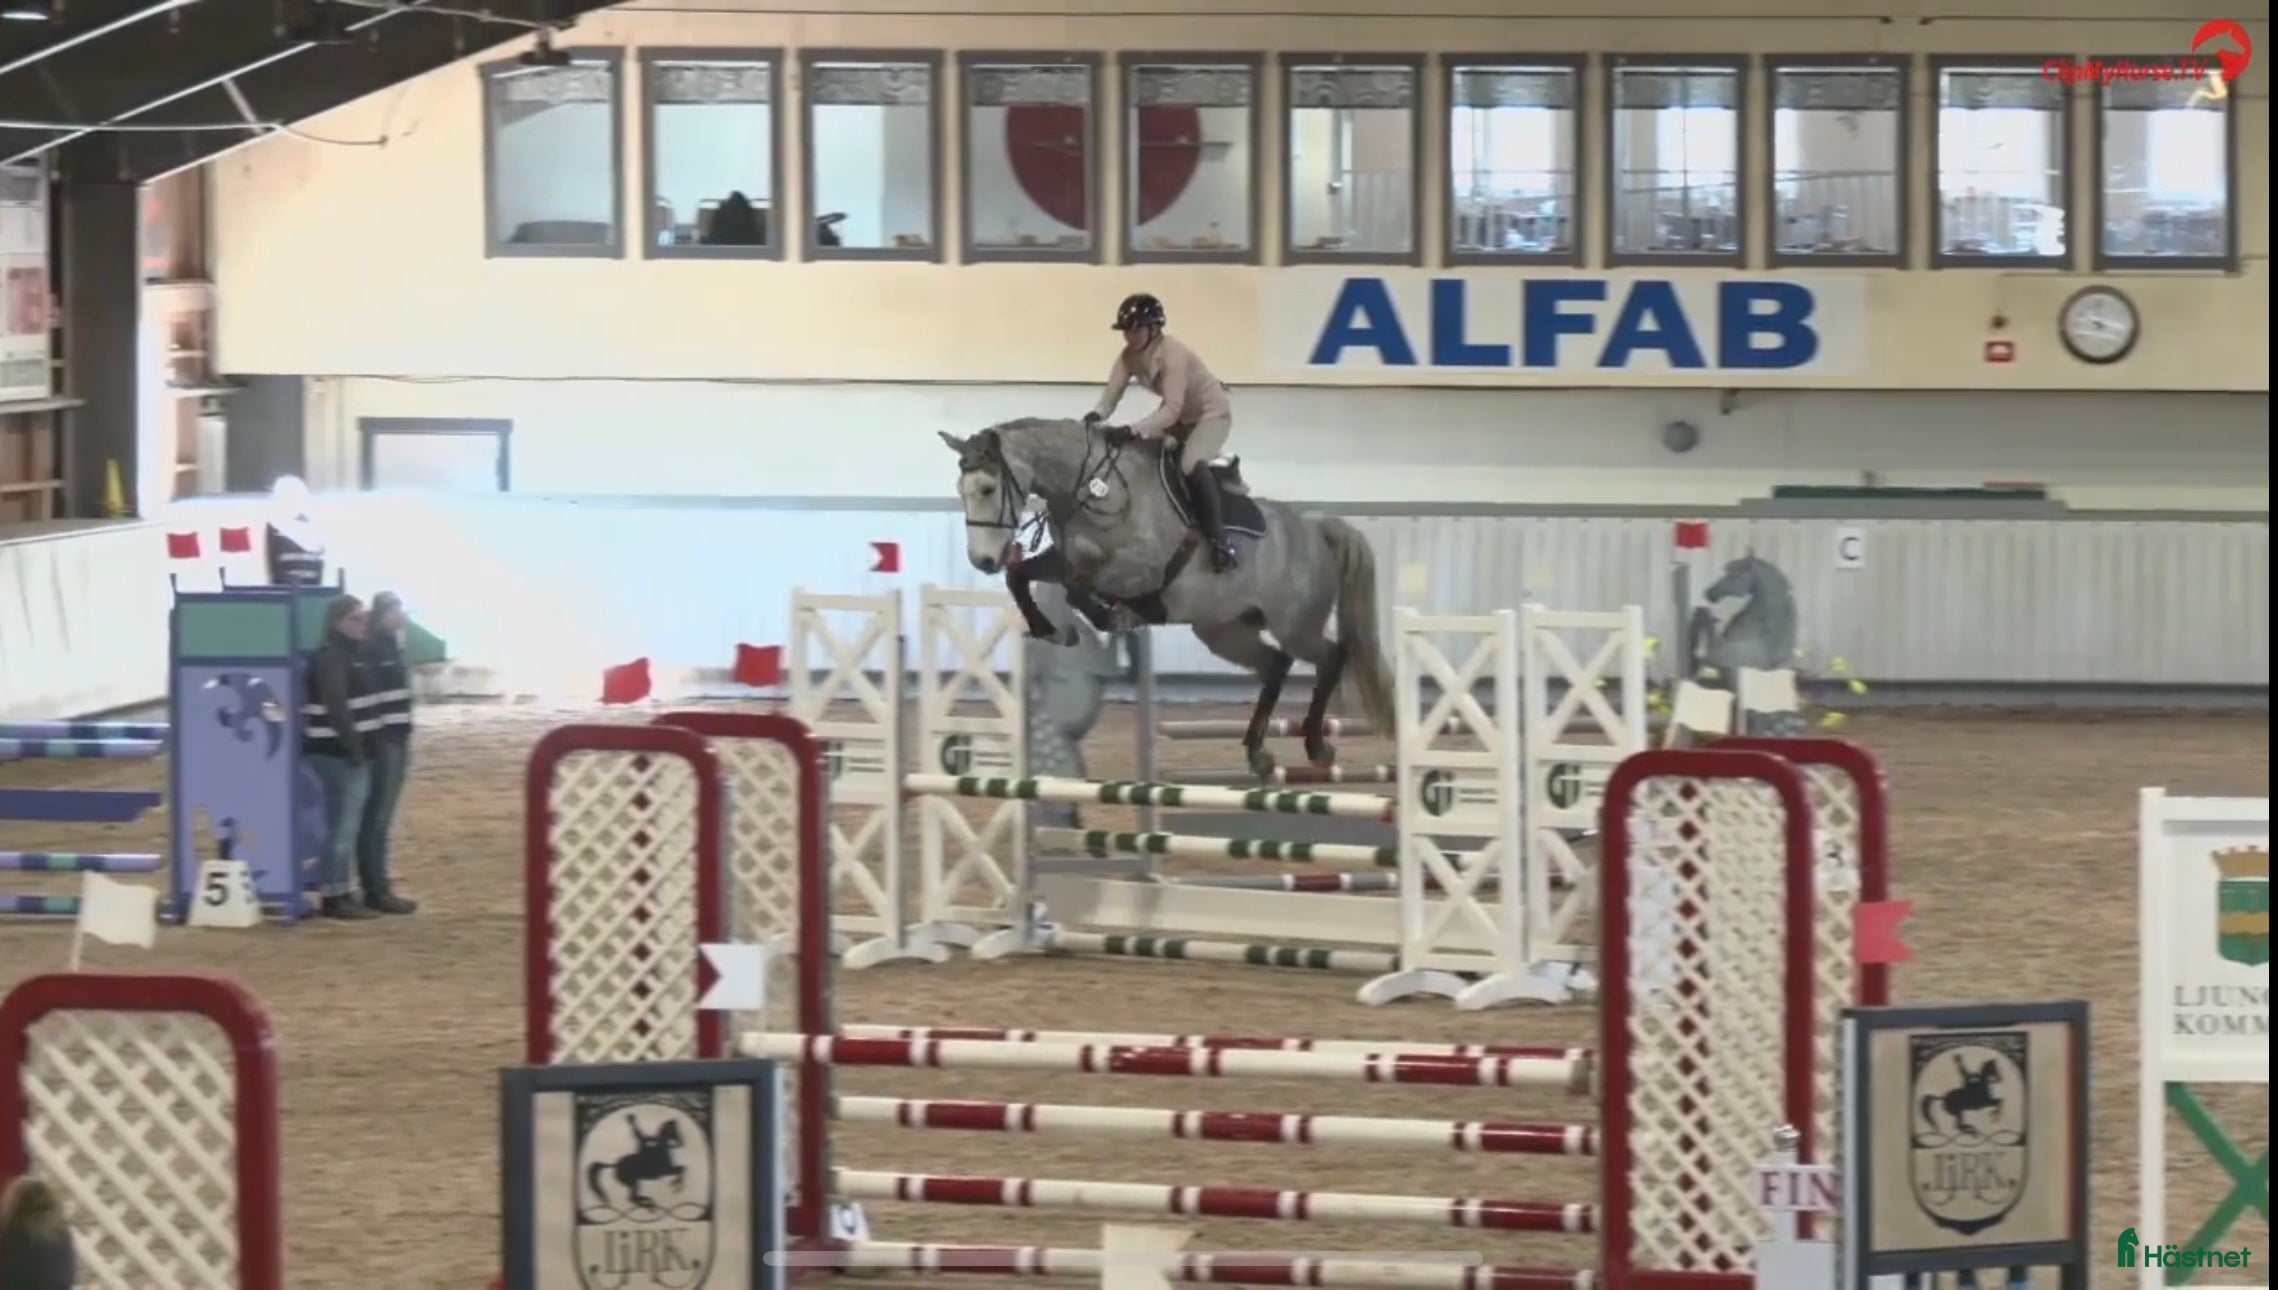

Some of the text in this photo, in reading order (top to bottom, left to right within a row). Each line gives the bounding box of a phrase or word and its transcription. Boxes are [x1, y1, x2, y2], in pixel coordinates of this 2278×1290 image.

[1308, 277, 1820, 369] ALFAB
[1839, 536, 1860, 561] C
[203, 871, 231, 907] 5
